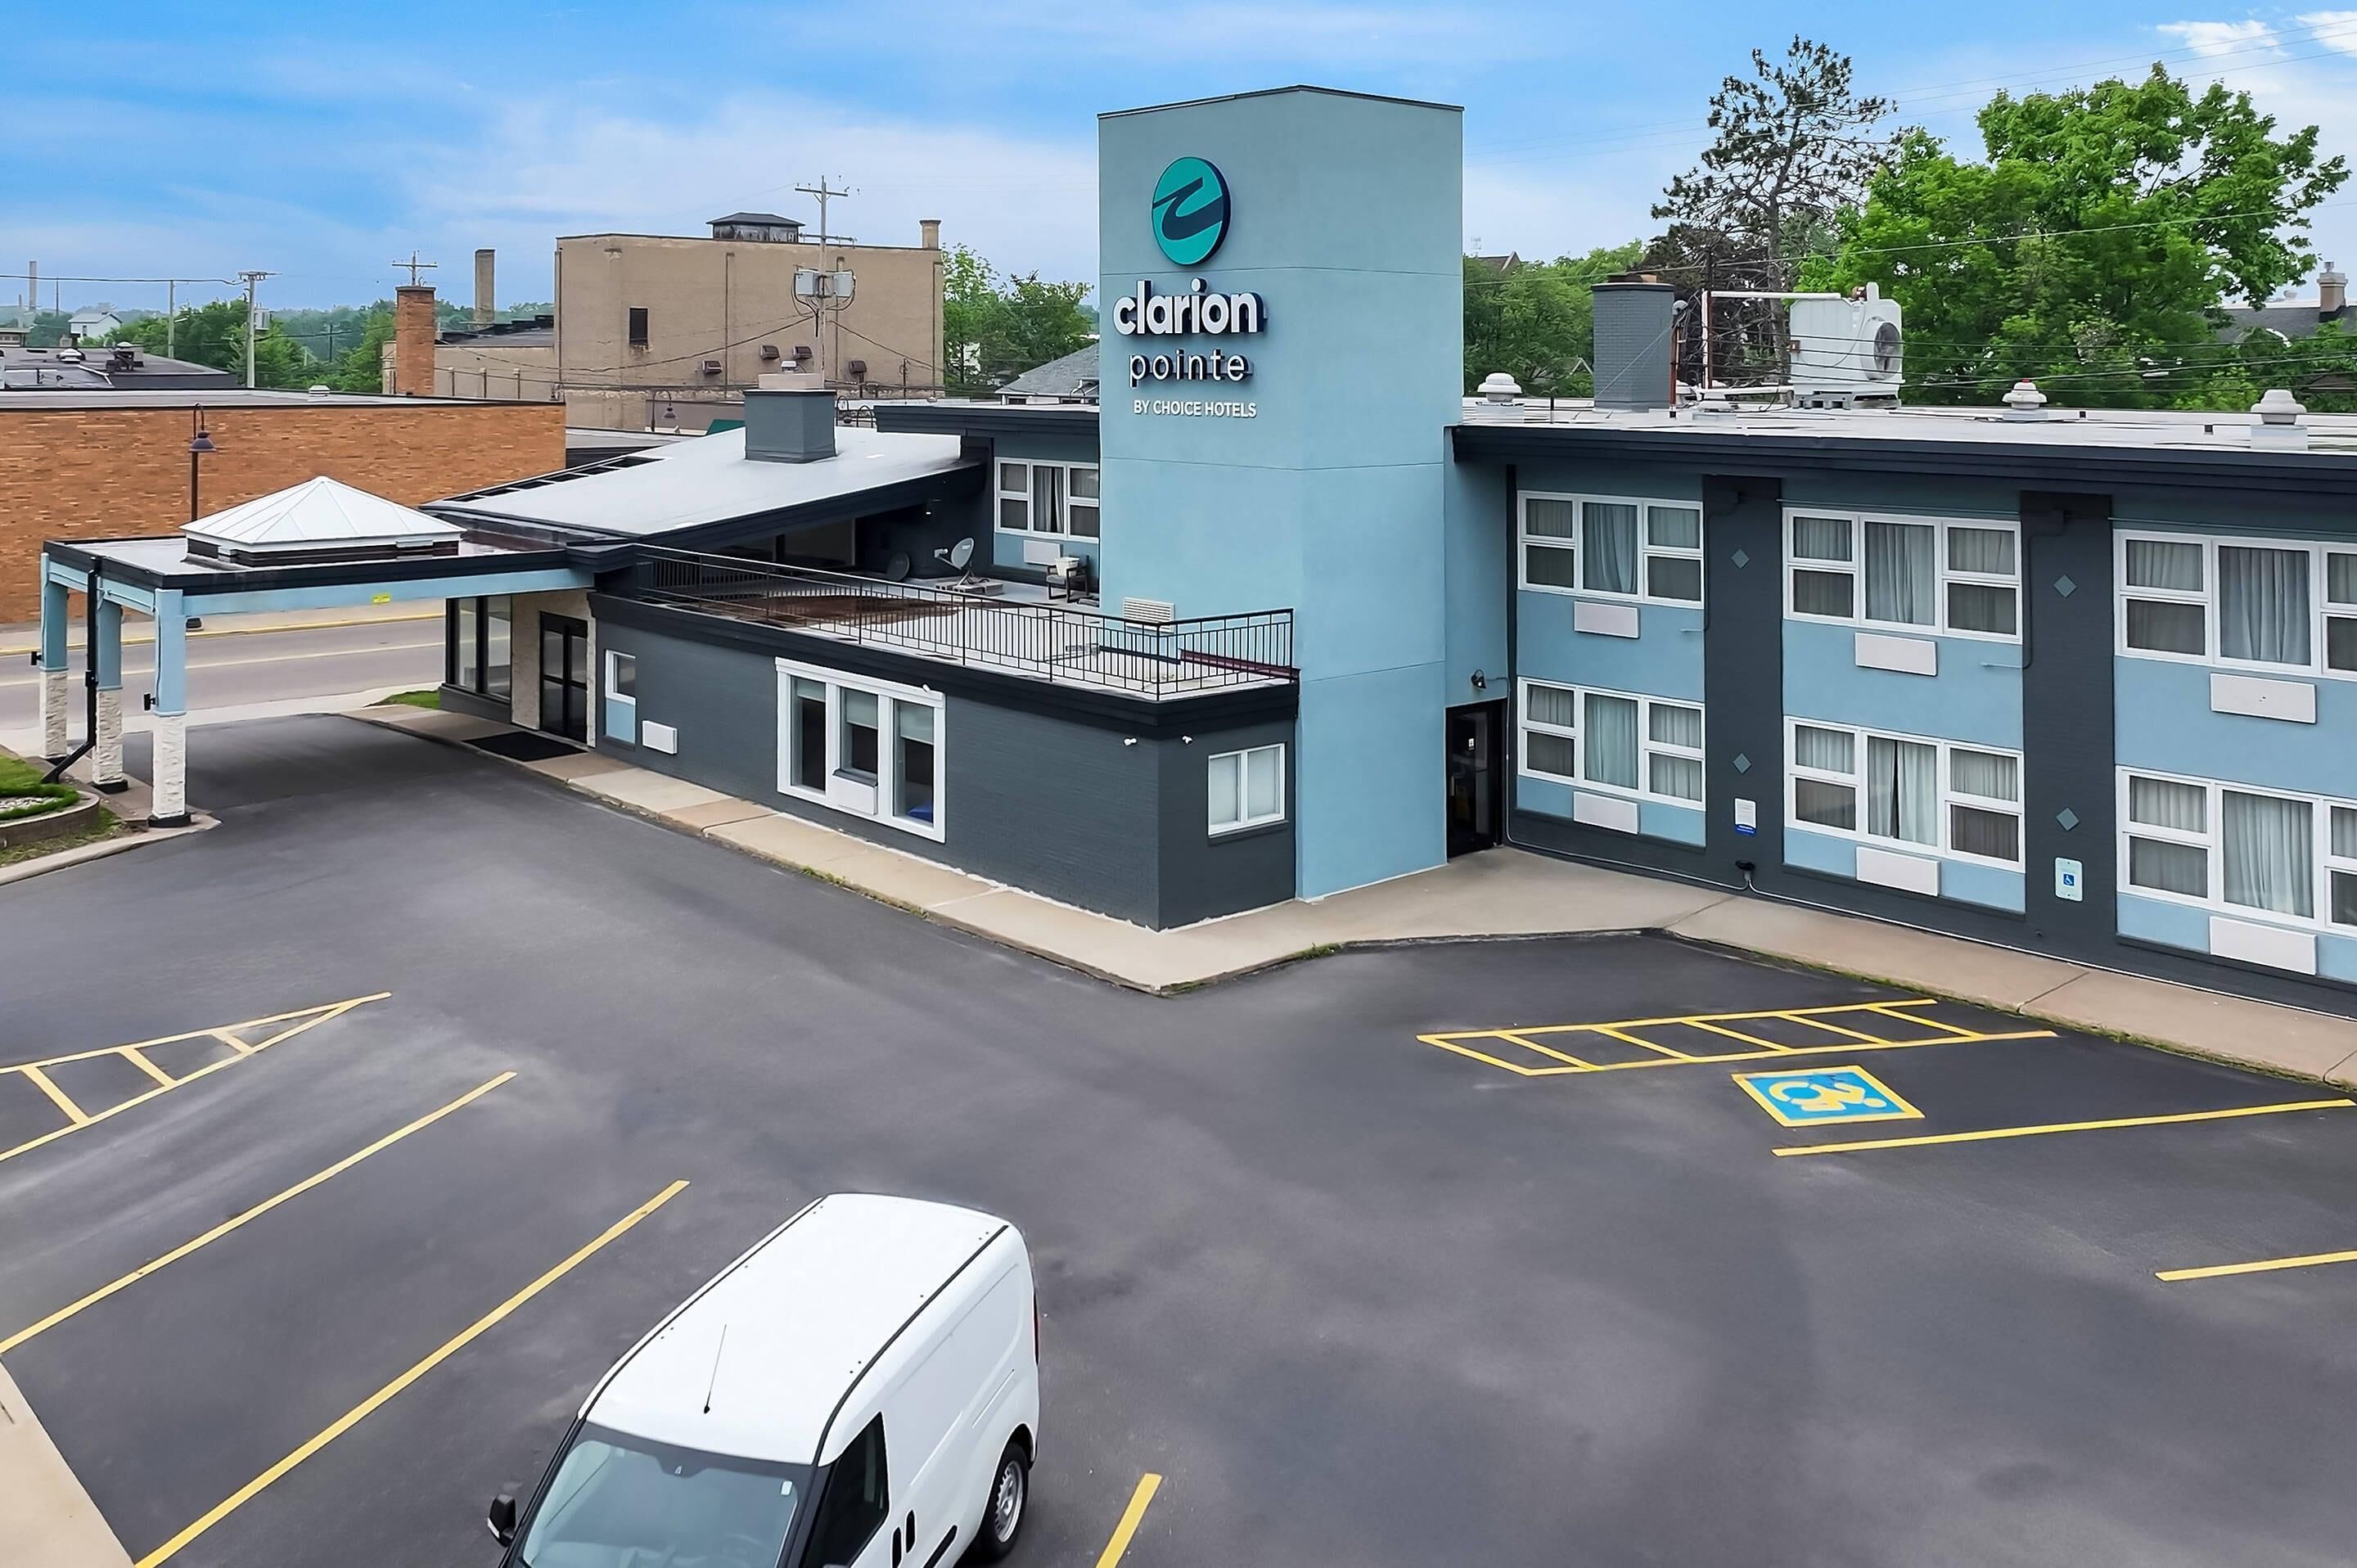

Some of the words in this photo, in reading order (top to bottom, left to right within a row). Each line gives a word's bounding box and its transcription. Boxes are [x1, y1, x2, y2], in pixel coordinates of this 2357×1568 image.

[1113, 277, 1262, 336] clarion
[1129, 348, 1249, 388] pointe
[1133, 399, 1150, 415] BY
[1153, 400, 1201, 417] CHOICE
[1205, 402, 1257, 418] HOTELS
